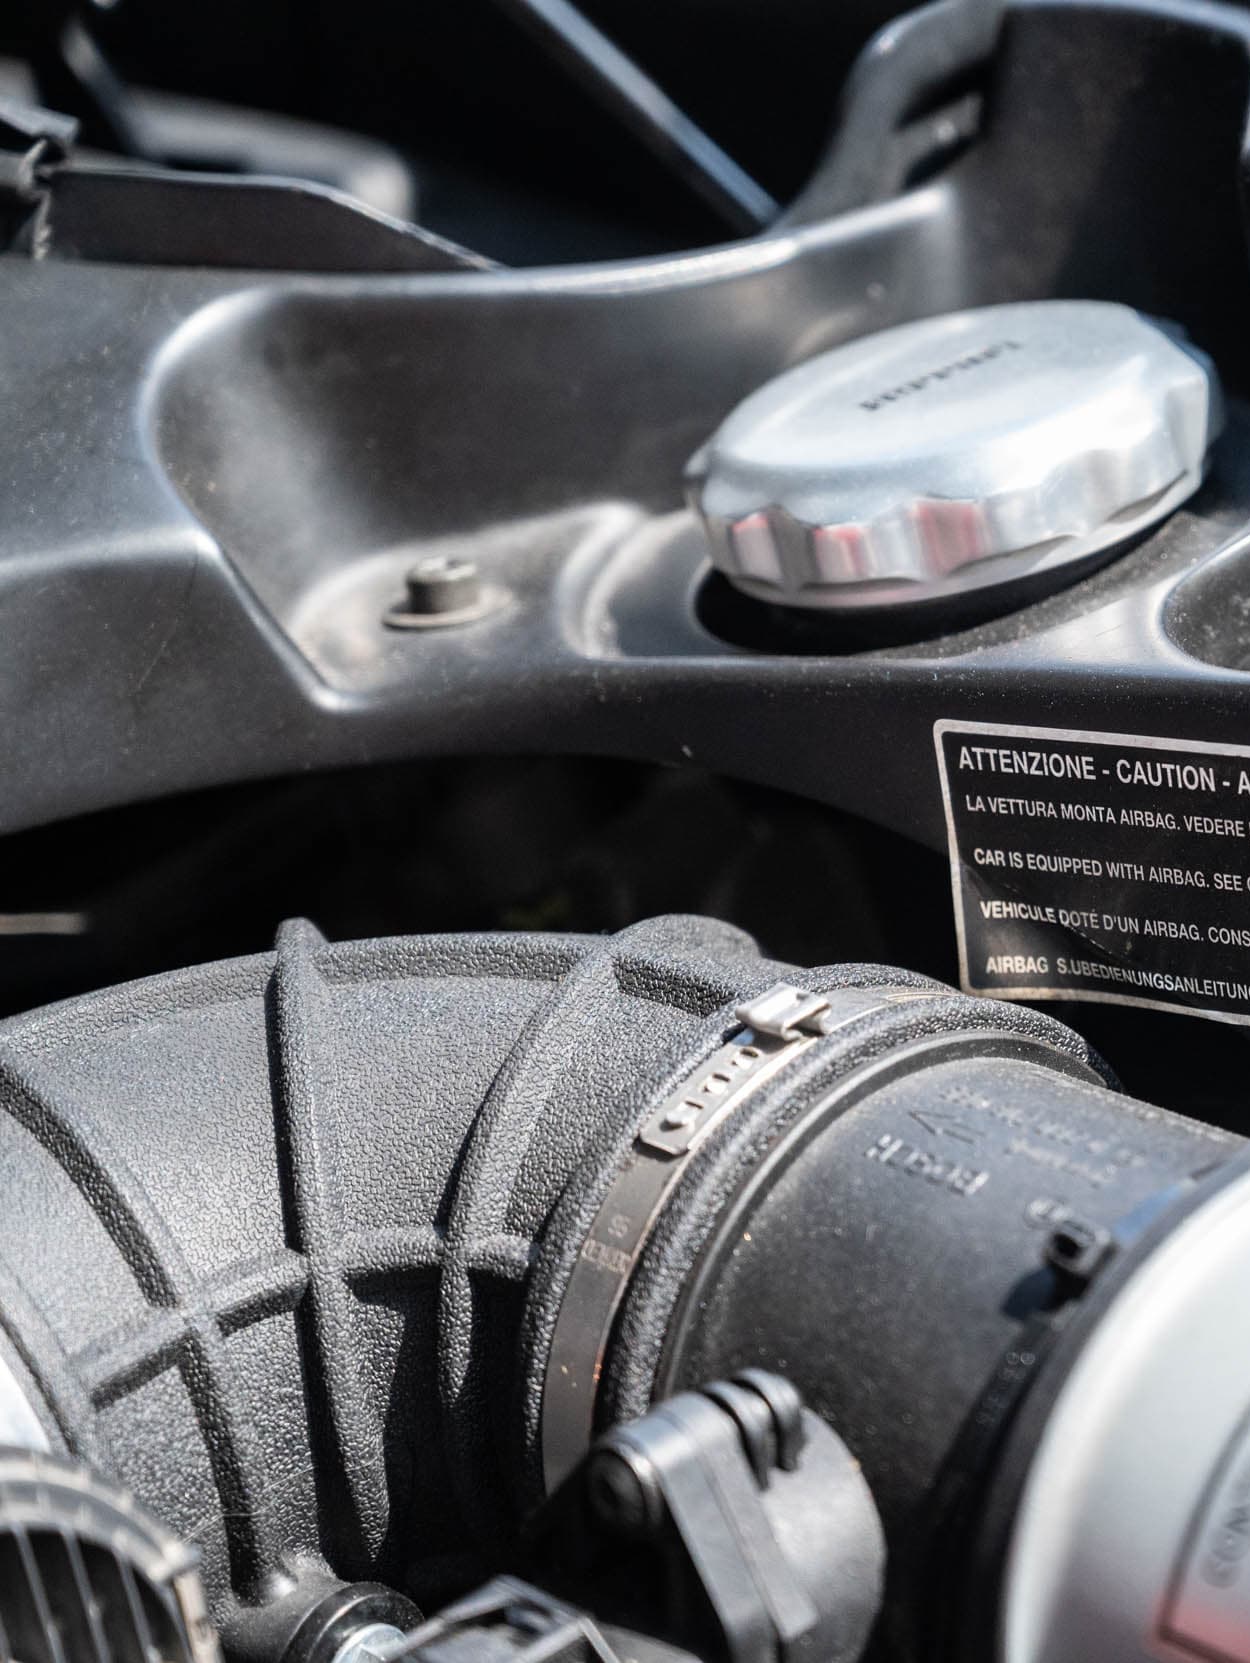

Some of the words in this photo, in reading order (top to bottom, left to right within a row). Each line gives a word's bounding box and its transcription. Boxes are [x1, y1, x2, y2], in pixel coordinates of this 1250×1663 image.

[959, 746, 1096, 780] ATTENZIONE
[1116, 759, 1216, 792] CAUTION
[965, 794, 986, 813] LA
[987, 796, 1058, 819] VETTURA
[1061, 803, 1117, 825] MONTA
[1120, 809, 1181, 831] AIRBAG.
[1183, 815, 1245, 838] VEDERE
[973, 847, 1006, 867] CAR
[1009, 851, 1024, 869] IS
[1026, 853, 1102, 877] EQUIPPED
[1106, 862, 1145, 882] WITH
[1148, 867, 1210, 889] AIRBAG.
[1213, 873, 1243, 892] SEE
[980, 900, 1056, 925] VEHICULE
[1103, 914, 1140, 934] D'UN
[1144, 919, 1204, 941] AIRBAG.
[986, 955, 1048, 974] AIRBAG
